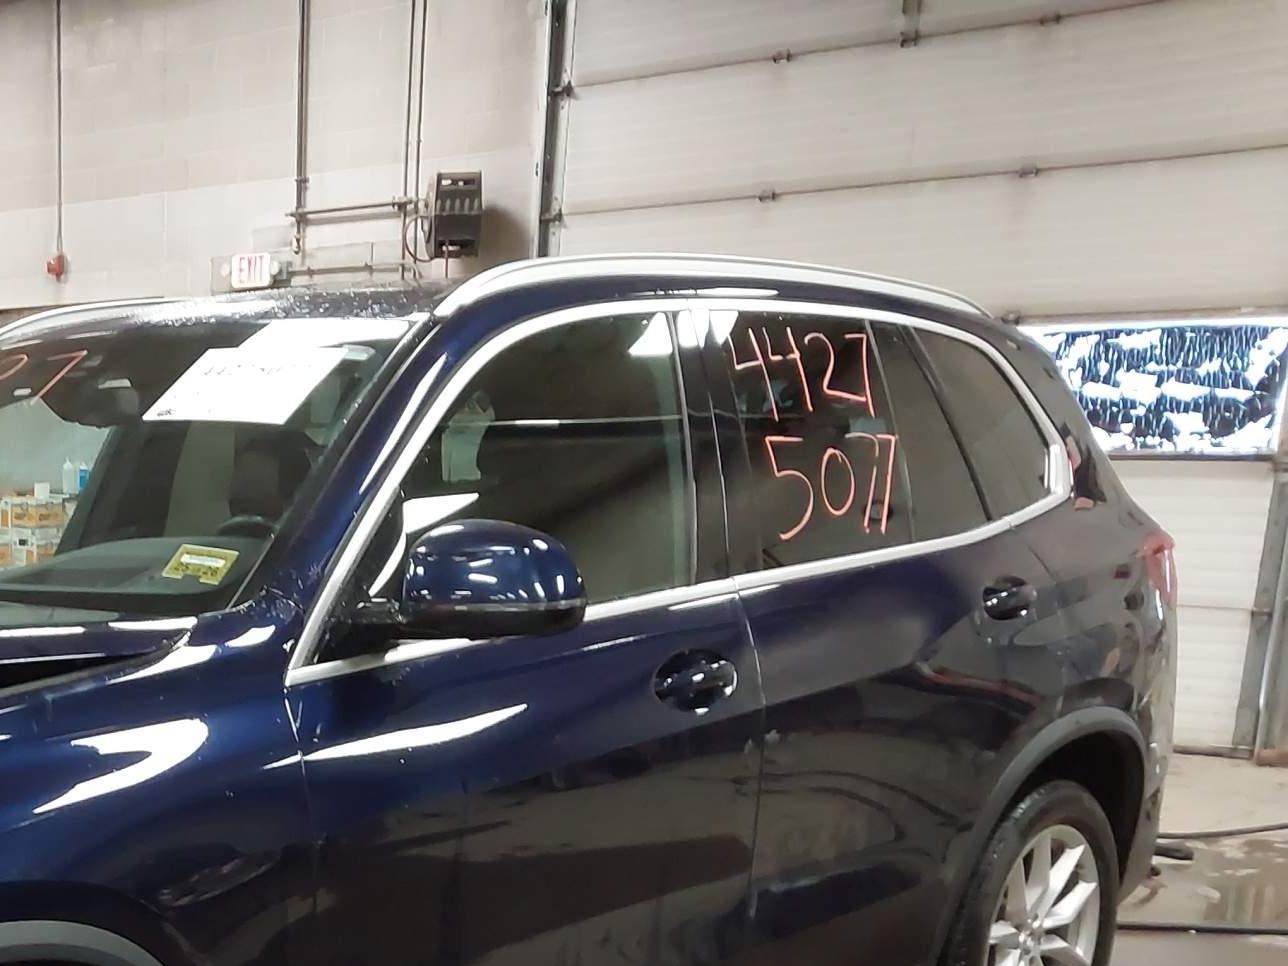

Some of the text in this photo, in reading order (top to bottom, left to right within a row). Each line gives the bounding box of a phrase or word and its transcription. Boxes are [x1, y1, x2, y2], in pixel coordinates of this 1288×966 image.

[238, 254, 265, 285] EXIT
[727, 326, 876, 423] 4427
[764, 431, 900, 541] 5077
